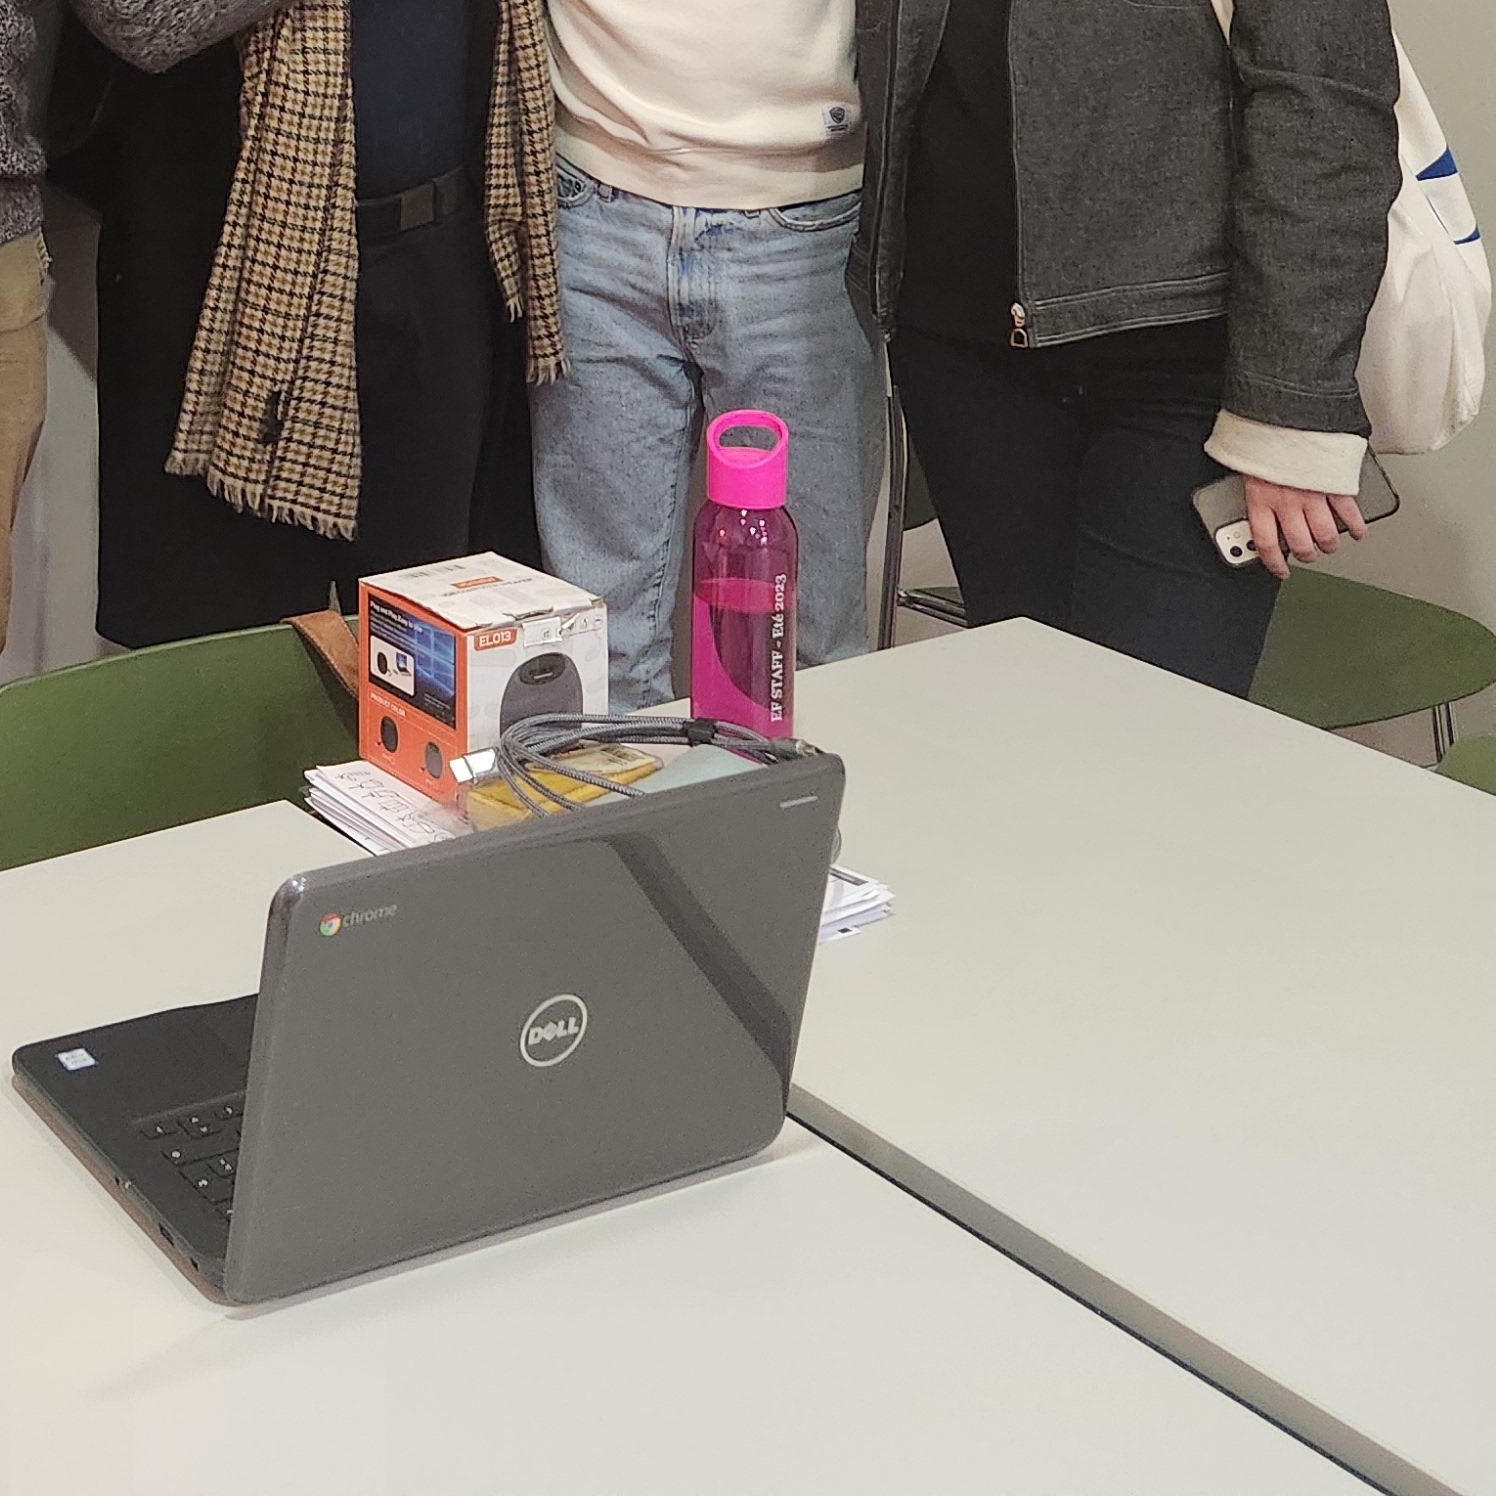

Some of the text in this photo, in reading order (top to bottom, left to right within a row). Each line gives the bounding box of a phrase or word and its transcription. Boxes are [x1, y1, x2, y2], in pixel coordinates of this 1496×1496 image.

[774, 573, 787, 611] 2023
[770, 650, 784, 700] STAFF
[770, 701, 783, 722] EF
[343, 904, 398, 927] chrome
[528, 1016, 579, 1045] DELL
